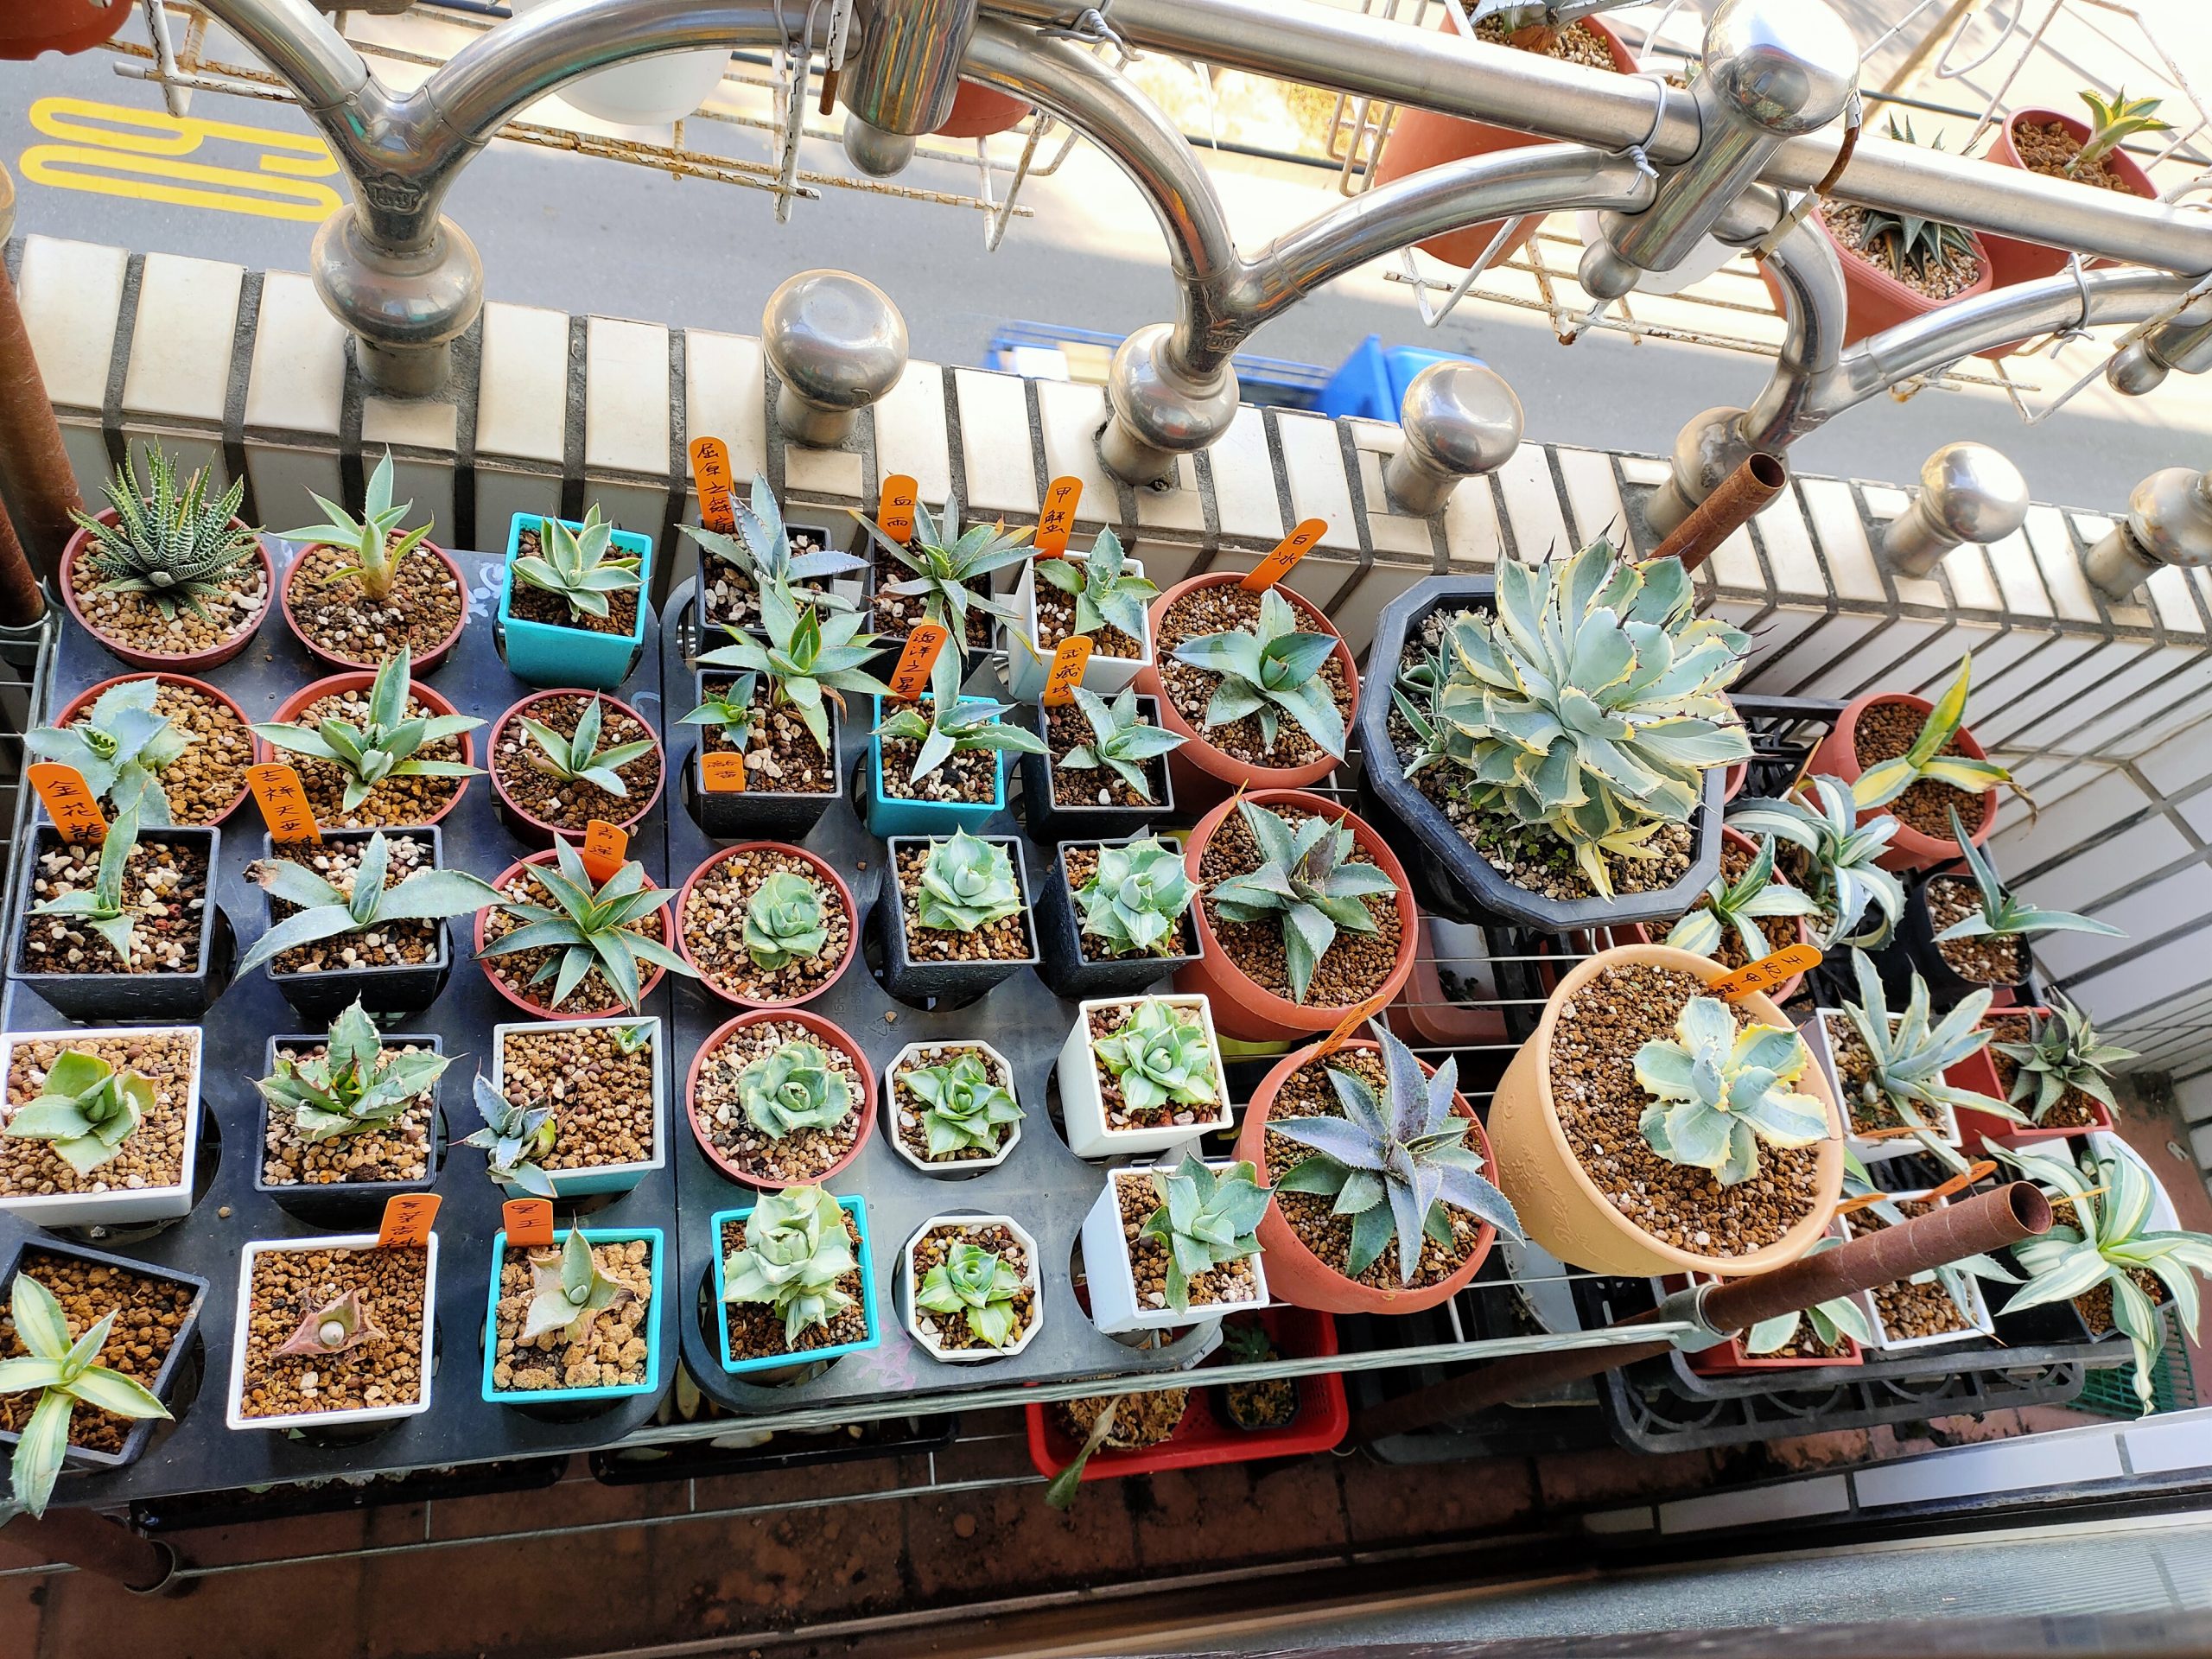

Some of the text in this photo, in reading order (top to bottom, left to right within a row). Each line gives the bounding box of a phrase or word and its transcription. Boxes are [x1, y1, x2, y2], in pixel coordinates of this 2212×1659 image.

[887, 495, 915, 528] 血雨
[1272, 532, 1312, 566] 白冰
[897, 631, 936, 695] 海洋之星
